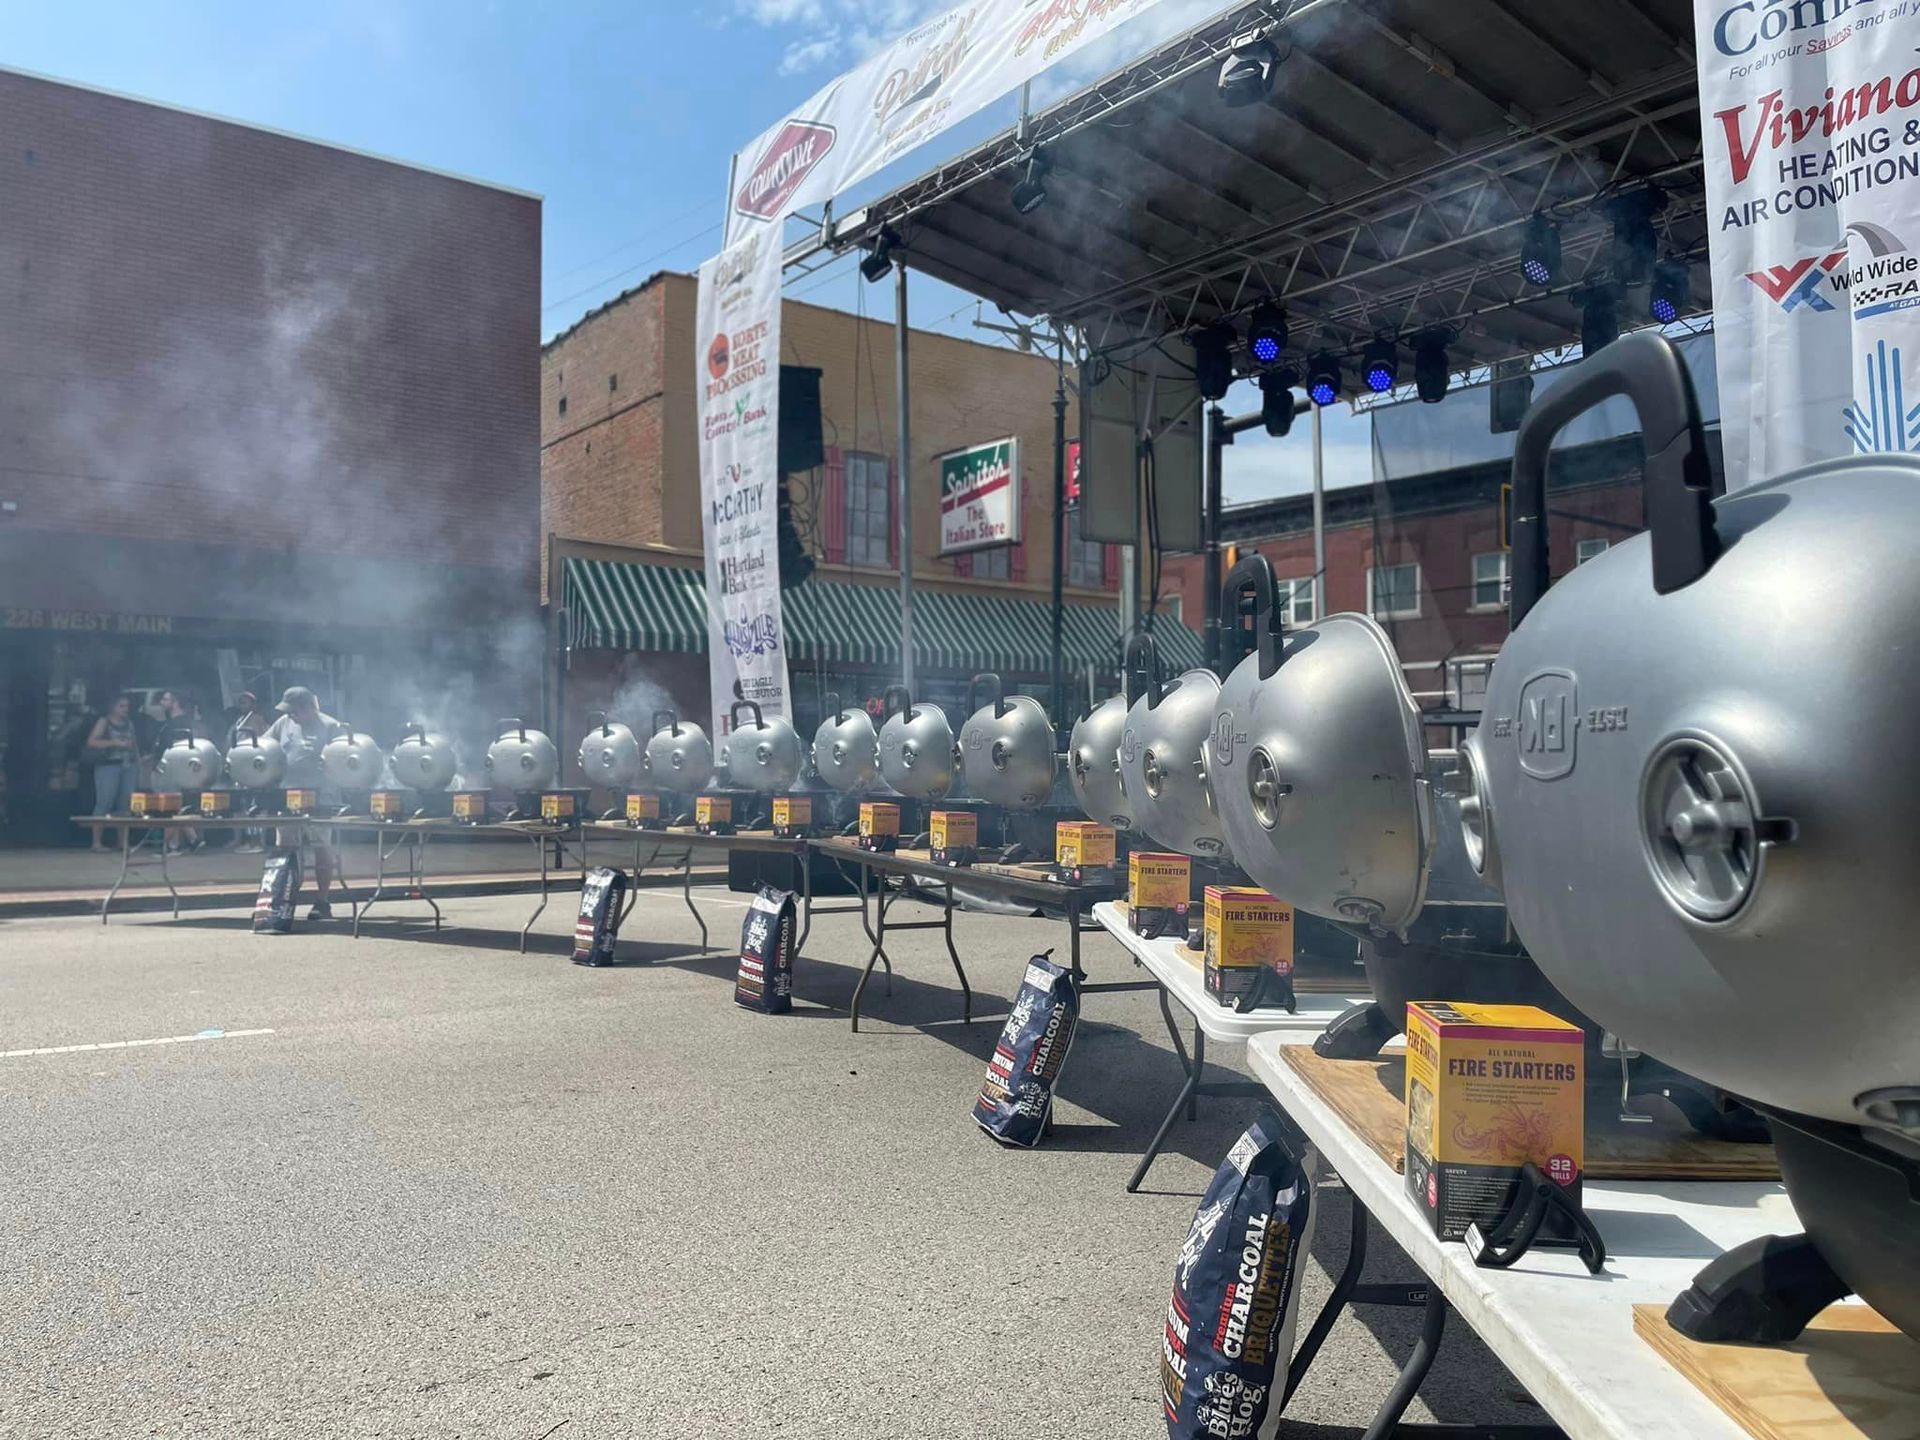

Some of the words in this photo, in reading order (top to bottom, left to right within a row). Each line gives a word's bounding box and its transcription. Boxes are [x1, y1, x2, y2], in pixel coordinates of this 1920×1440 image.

[1729, 64, 1752, 80] For
[1755, 54, 1768, 71] all
[1771, 43, 1803, 66] your
[1806, 24, 1852, 53] Savings
[1855, 12, 1885, 30] and
[1889, 1, 1906, 20] all
[1713, 67, 1920, 185] Viviano
[1779, 127, 1890, 183] HEATING
[1902, 119, 1920, 146] &
[1721, 198, 1769, 231] AIR
[1867, 256, 1918, 280] Wide
[946, 527, 976, 545] Italian
[979, 522, 1005, 540] Store
[967, 506, 984, 522] The
[50, 609, 111, 631] WEST
[118, 614, 173, 634] MAIN
[1226, 911, 1245, 920] FIRE
[1247, 911, 1290, 922] STARTERS
[1032, 1001, 1066, 1076] CHARCOAL
[1488, 1048, 1500, 1057] ALL
[1503, 1049, 1537, 1059] NATURAL
[1448, 1058, 1487, 1077] FIRE
[1492, 1060, 1576, 1081] STARTERS
[1551, 1159, 1571, 1171] 32
[1222, 1212, 1269, 1359] CHARCOAL
[1243, 1219, 1290, 1366] BRIQUETTES
[1213, 1282, 1237, 1352] Premium
[1208, 1372, 1238, 1439] Blues
[1229, 1386, 1262, 1437] Hog
